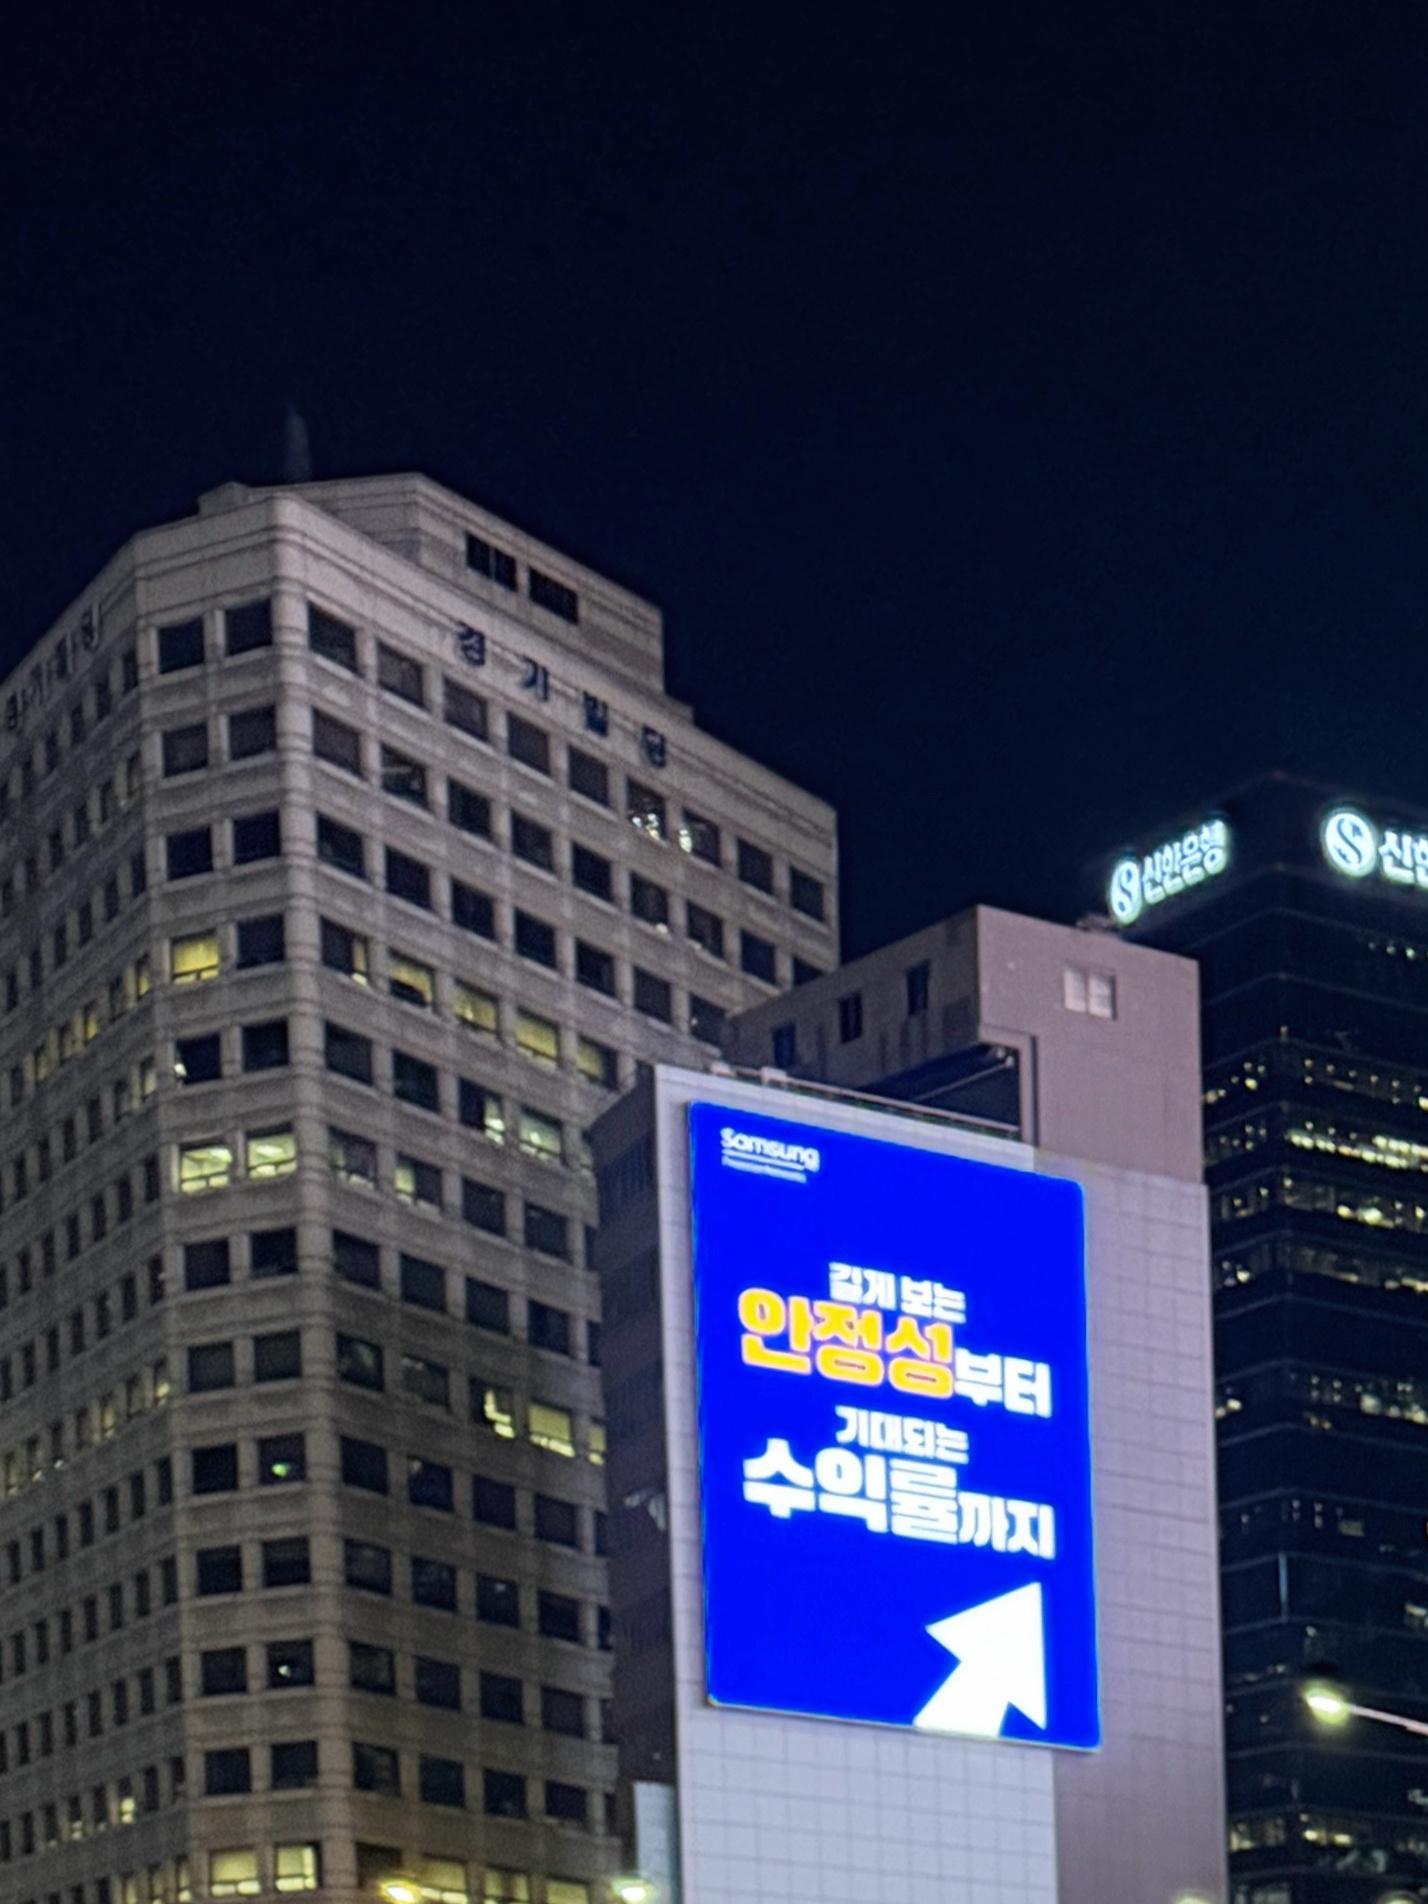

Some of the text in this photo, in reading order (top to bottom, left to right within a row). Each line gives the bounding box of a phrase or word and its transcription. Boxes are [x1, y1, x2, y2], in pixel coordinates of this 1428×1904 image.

[1142, 818, 1229, 905] 신한은행
[900, 1275, 966, 1324] 보는
[738, 1287, 1054, 1419] 안정성부터
[835, 1405, 970, 1465] 기대되는
[742, 1436, 1056, 1561] 수익률까지
